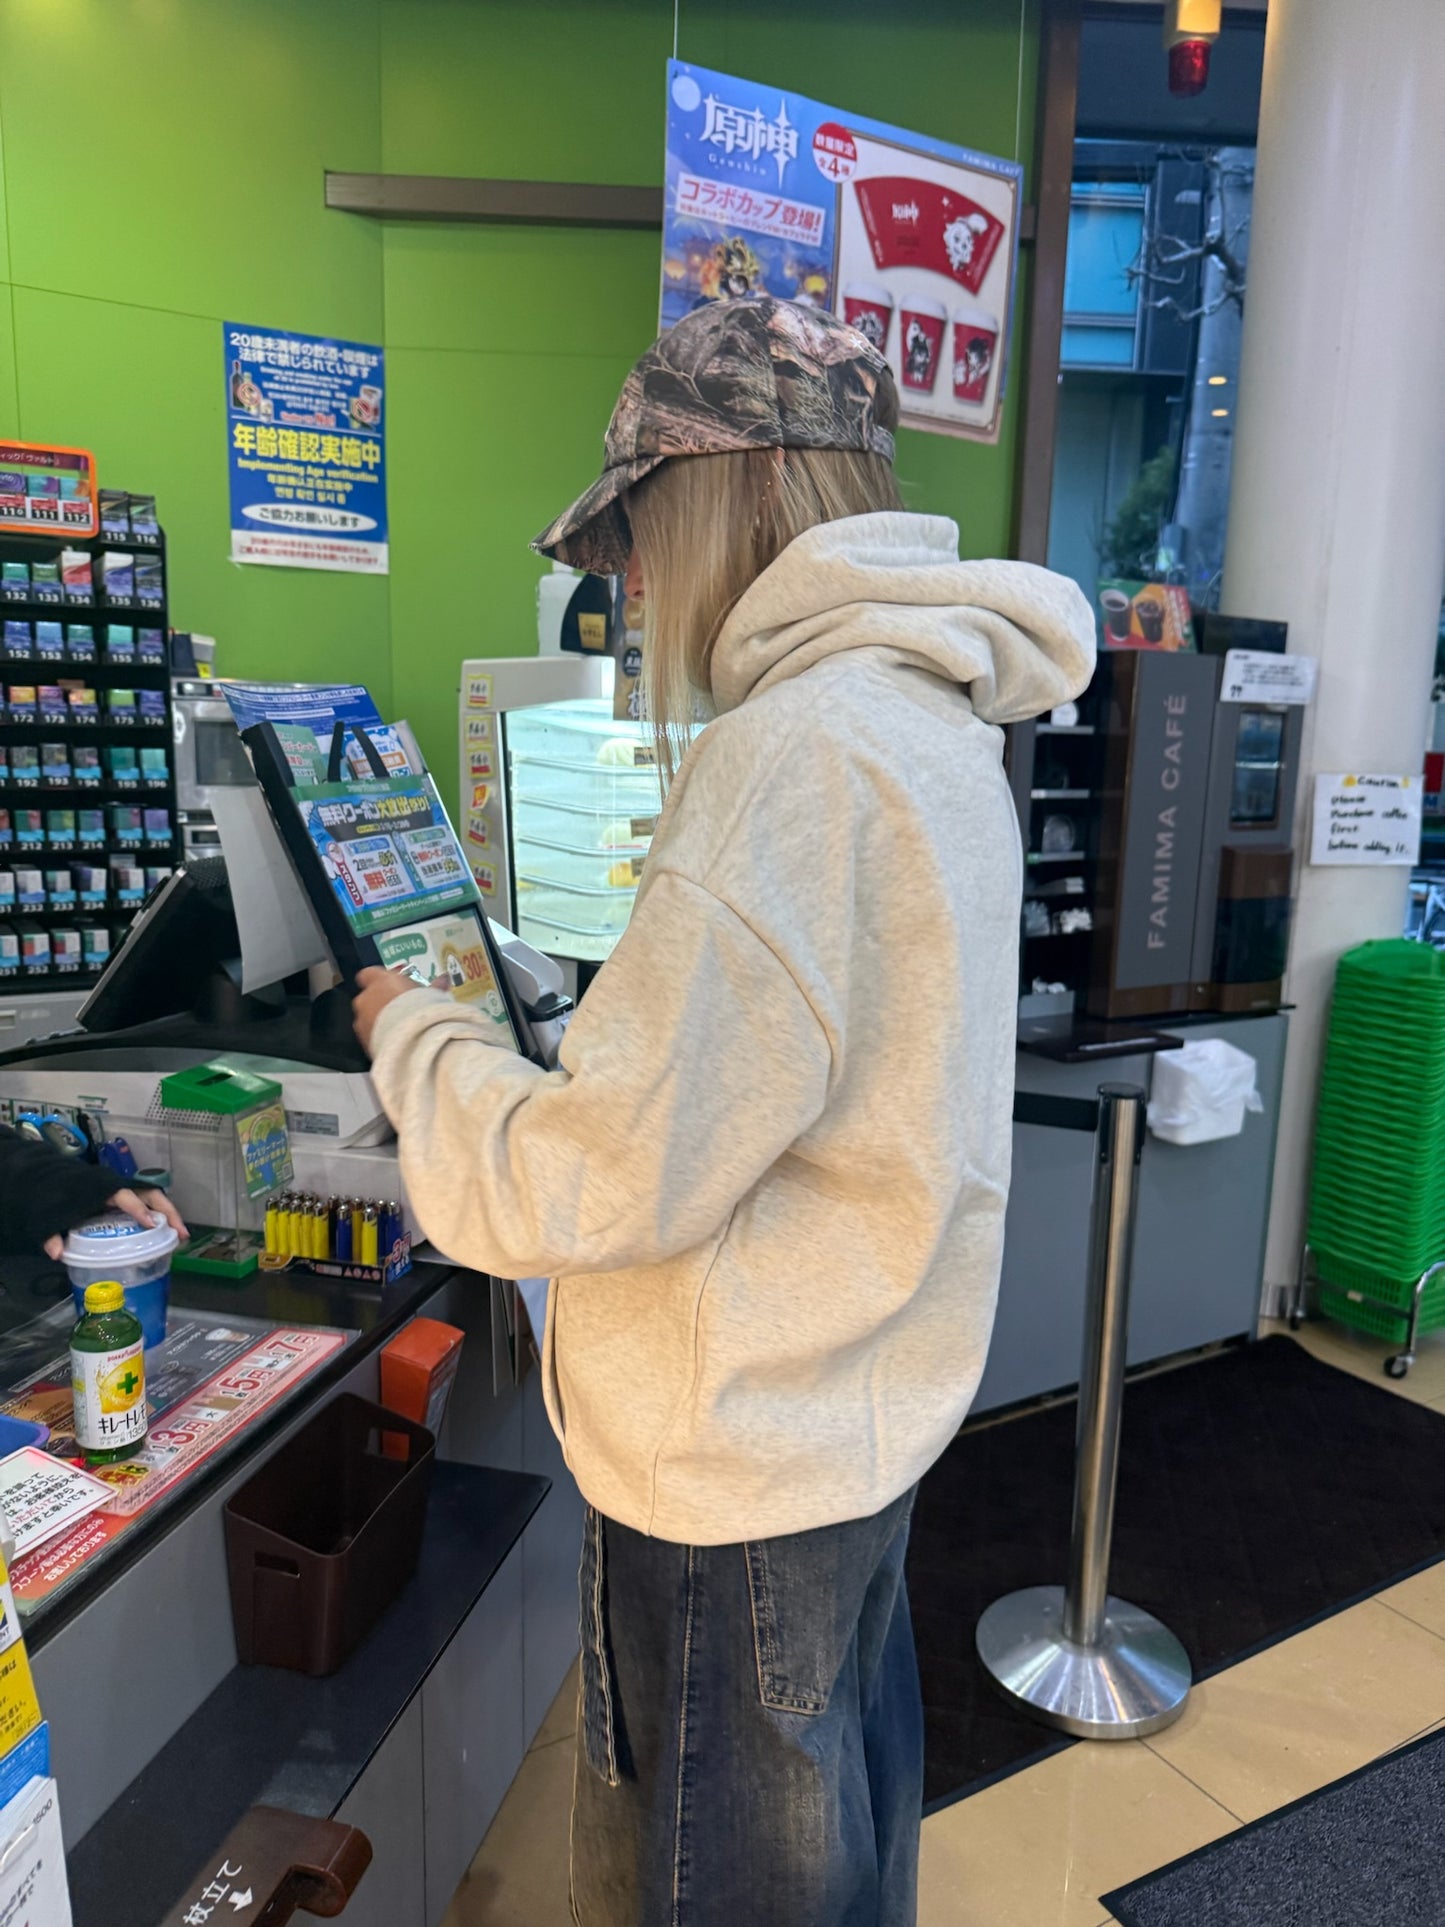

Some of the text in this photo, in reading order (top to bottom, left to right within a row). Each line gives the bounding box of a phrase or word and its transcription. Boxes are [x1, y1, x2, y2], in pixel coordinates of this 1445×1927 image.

[700, 93, 799, 190] 原神
[708, 152, 768, 177] Genshin
[680, 178, 822, 234] コラボカップ登場!
[233, 423, 382, 470] 年齢確認実施中
[34, 509, 55, 519] 111
[65, 513, 88, 523] 112
[259, 507, 361, 529] ご協力お願いします
[6, 591, 28, 601] 132
[8, 649, 30, 660] 152
[40, 651, 62, 661] 153
[13, 714, 35, 724] 172
[75, 715, 97, 724] 174
[17, 778, 39, 788] 192
[48, 777, 70, 786] 193
[1147, 695, 1186, 949] FAMIMA CAFÉ
[21, 842, 43, 850] 212
[22, 904, 44, 913] 232
[28, 966, 49, 975] 252
[182, 1859, 243, 1926] 杖立て
